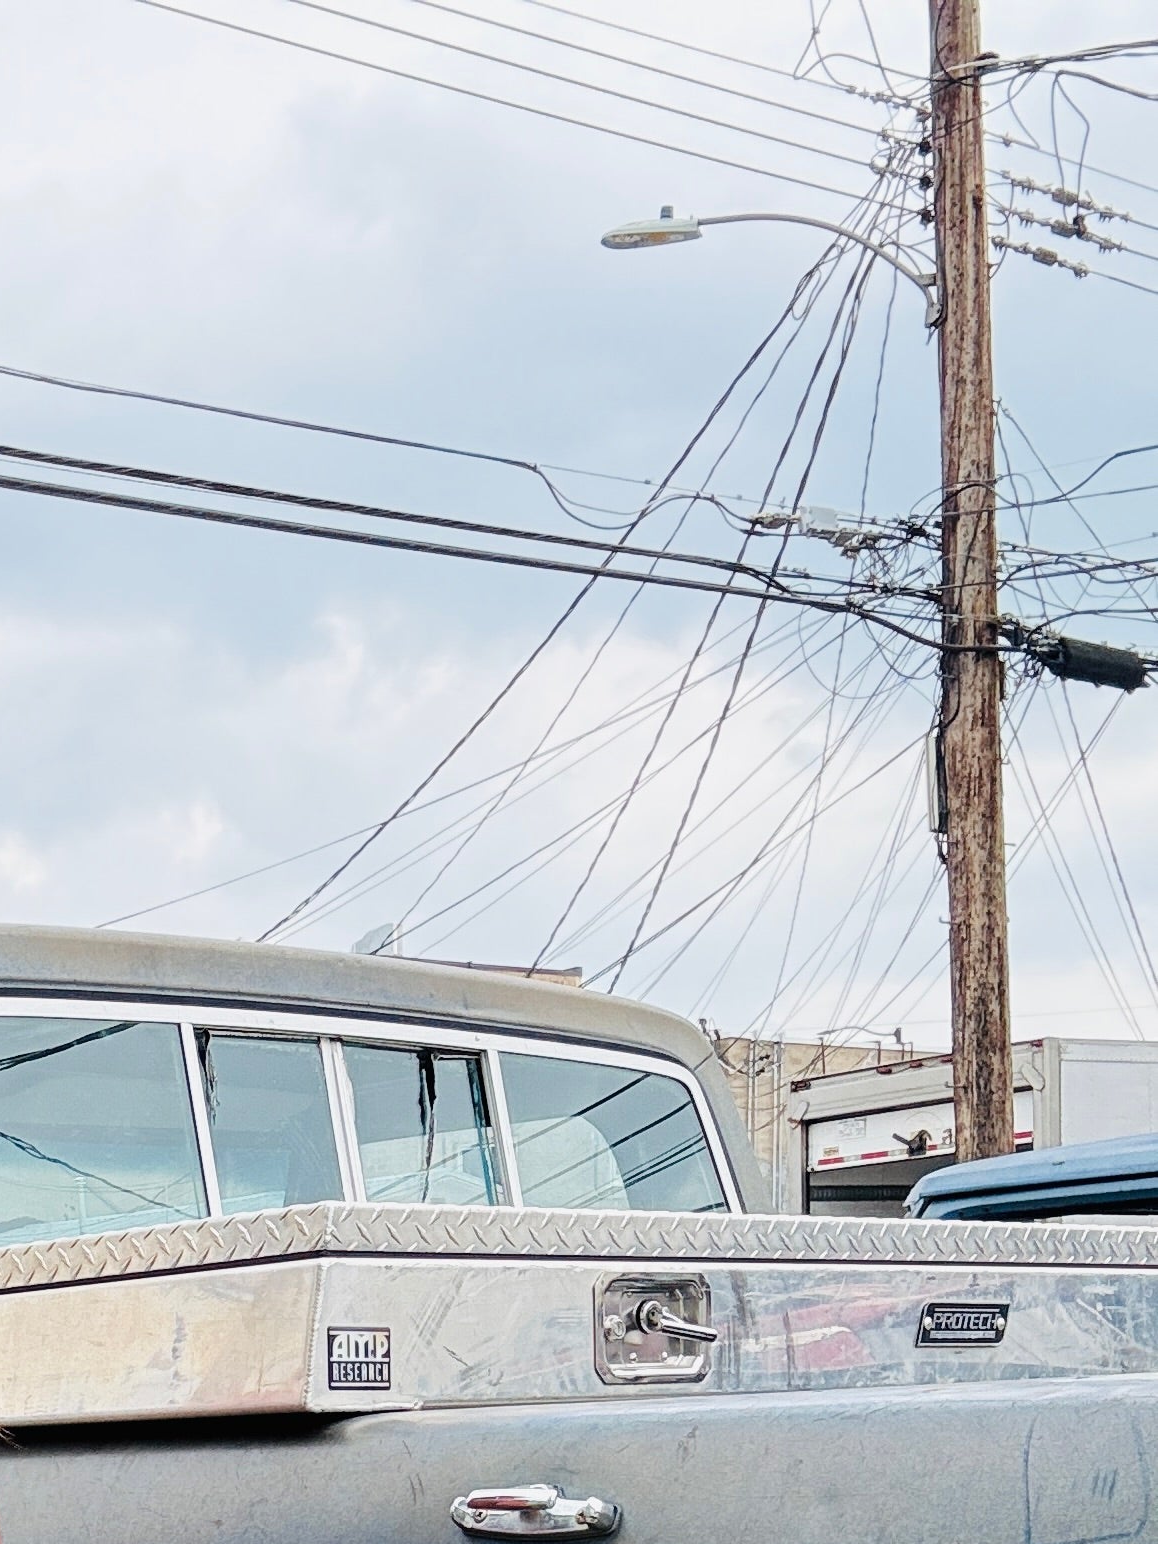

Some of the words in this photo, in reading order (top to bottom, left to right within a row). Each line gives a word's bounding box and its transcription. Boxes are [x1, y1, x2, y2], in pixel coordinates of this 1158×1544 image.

[932, 1312, 1002, 1330] PROTECH
[332, 1333, 389, 1359] AMP
[332, 1362, 389, 1382] RESEARCH
